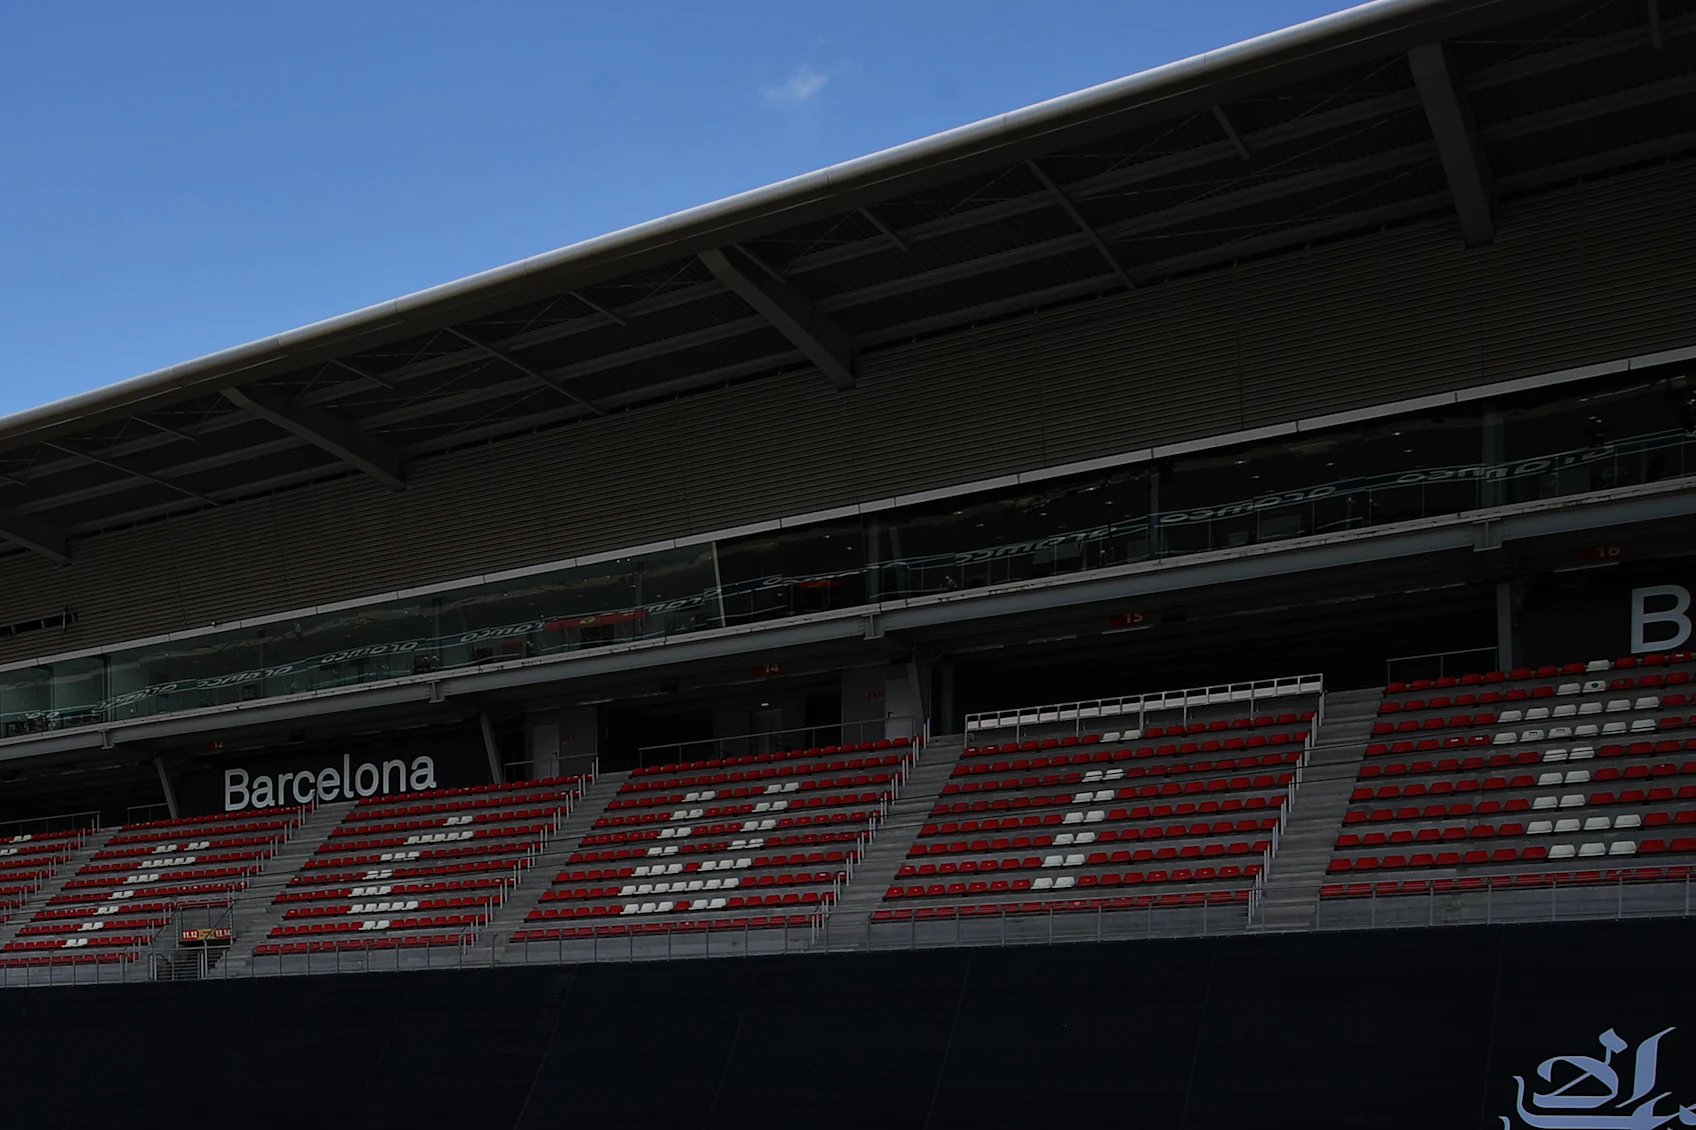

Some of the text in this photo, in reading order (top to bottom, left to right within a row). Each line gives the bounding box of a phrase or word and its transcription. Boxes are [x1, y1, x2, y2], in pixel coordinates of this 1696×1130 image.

[1123, 610, 1144, 624] 15
[763, 664, 779, 674] 14
[224, 754, 436, 812] Barcelona
